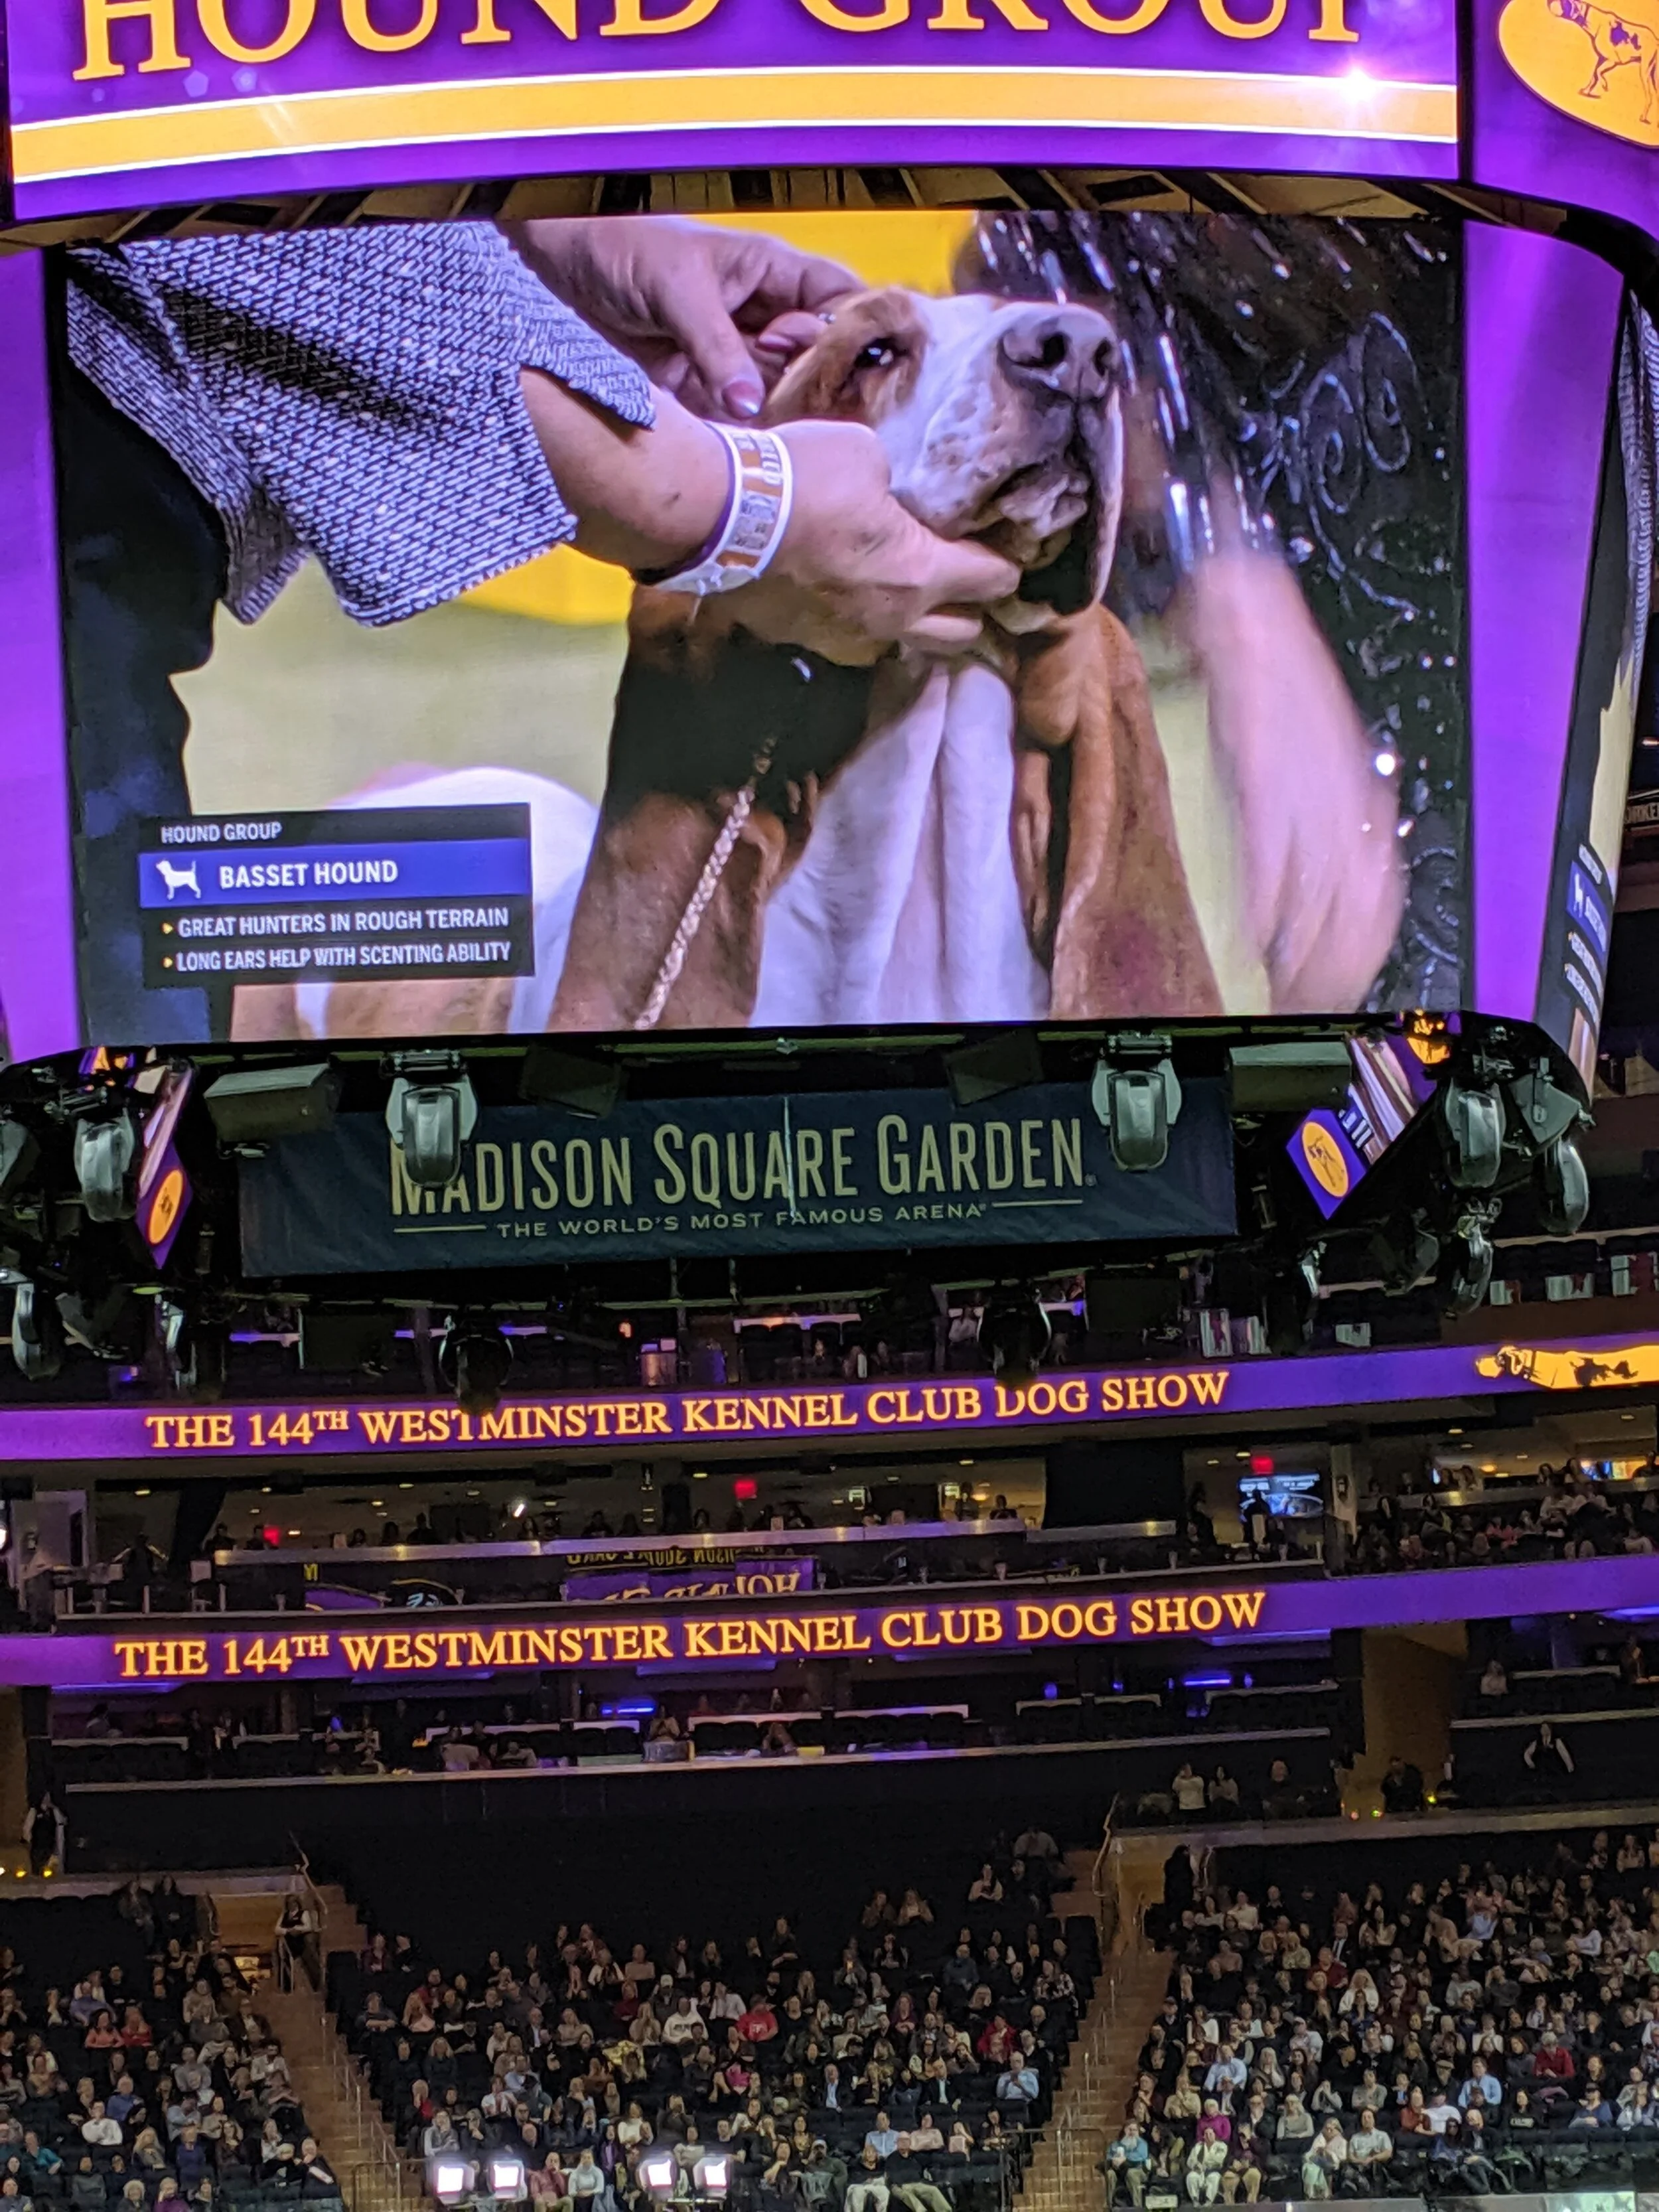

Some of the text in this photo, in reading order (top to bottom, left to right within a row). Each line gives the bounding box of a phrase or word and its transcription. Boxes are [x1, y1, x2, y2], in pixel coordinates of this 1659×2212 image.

[161, 822, 283, 844] HOUND GROUP
[219, 860, 398, 889] BASSET HOUND
[178, 907, 509, 938] GREAT HUNTERS IN ROUGH TERRAIN
[176, 940, 511, 972] LONG EARS HELP WITH SCENTING ABILITY
[390, 1137, 633, 1215] MADISON
[654, 1123, 859, 1209] SQUARE
[498, 1222, 547, 1238] THE
[559, 1216, 679, 1234] WORLD'S
[690, 1212, 764, 1229] MOST
[776, 1207, 883, 1226] FAMOUS
[145, 1372, 1229, 1448] THE 144TH WESTMINSTER KENNEL CLUB DOG SHOW
[114, 1592, 1265, 1677] THE 144TH WESTMINSTER KENNEL CLUB DOG SHOW
